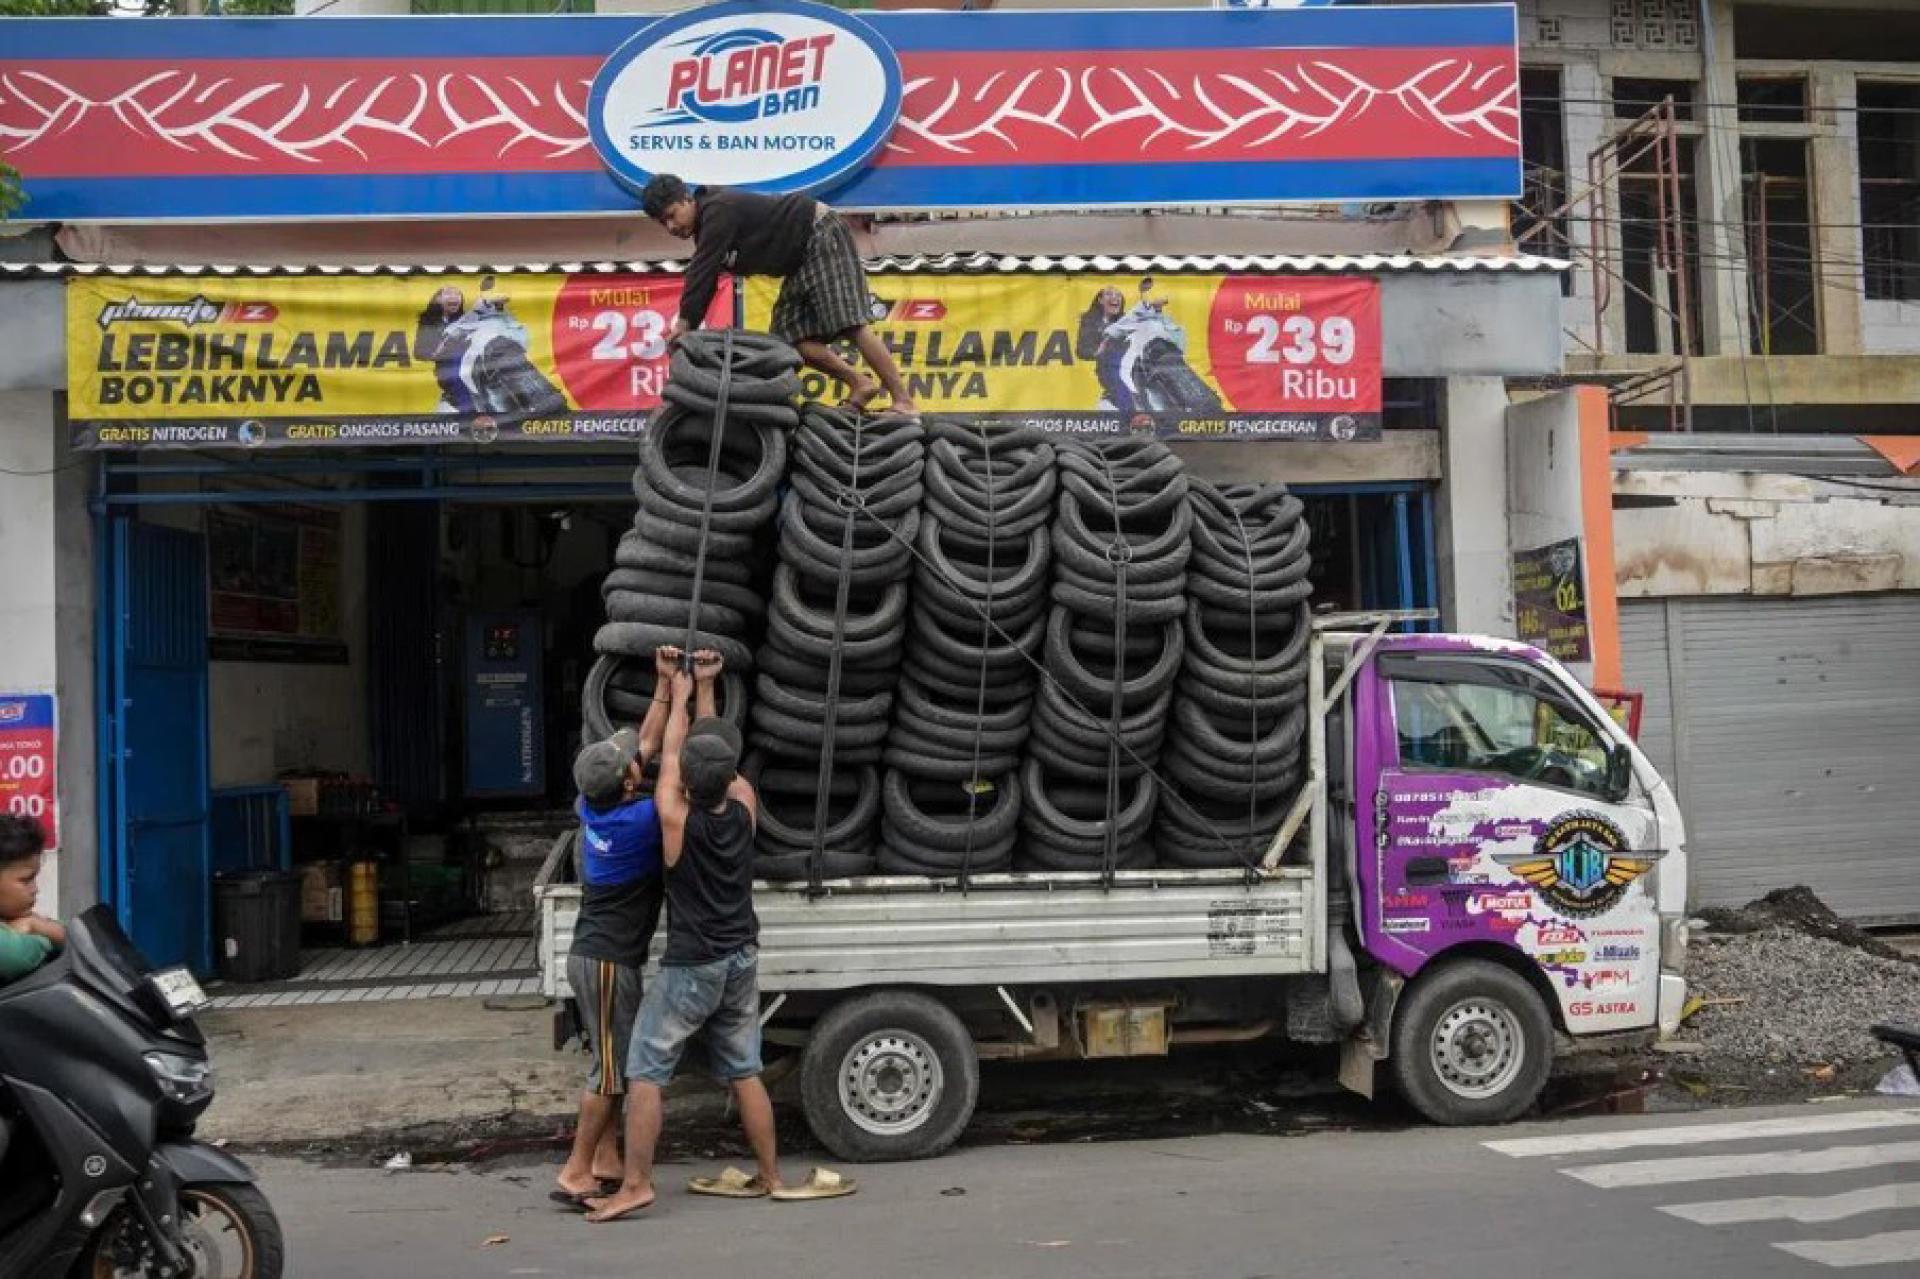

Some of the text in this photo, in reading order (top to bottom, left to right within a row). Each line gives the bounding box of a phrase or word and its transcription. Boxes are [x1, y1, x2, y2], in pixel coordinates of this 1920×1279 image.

[667, 33, 836, 109] PLANET
[762, 86, 821, 118] BAN
[630, 135, 836, 150] SERVIS & BAN MOTOR
[591, 288, 650, 306] Mulai
[1245, 292, 1301, 311] Mulai
[568, 310, 681, 361] Rp 23
[1225, 316, 1356, 365] Rp 239
[97, 331, 411, 372] LEBIH LAMA
[926, 331, 1074, 366] LAMA
[100, 374, 323, 405] BOTAKNYA
[631, 366, 669, 397] Ri
[801, 372, 988, 400] OTNYA
[1283, 369, 1356, 400] Ribu
[100, 427, 228, 441] GRATIS NITROGEN
[288, 423, 459, 439] GRATIS ONGKOS PASANG
[522, 418, 647, 434] GRATIS PENGECEK
[1066, 419, 1120, 432] PASANG
[1179, 420, 1317, 433] GRATIS PENGECEKAN
[0, 755, 44, 779] .00
[1486, 897, 1527, 908] MOTUL
[1568, 1002, 1636, 1016] GS ASTRA
